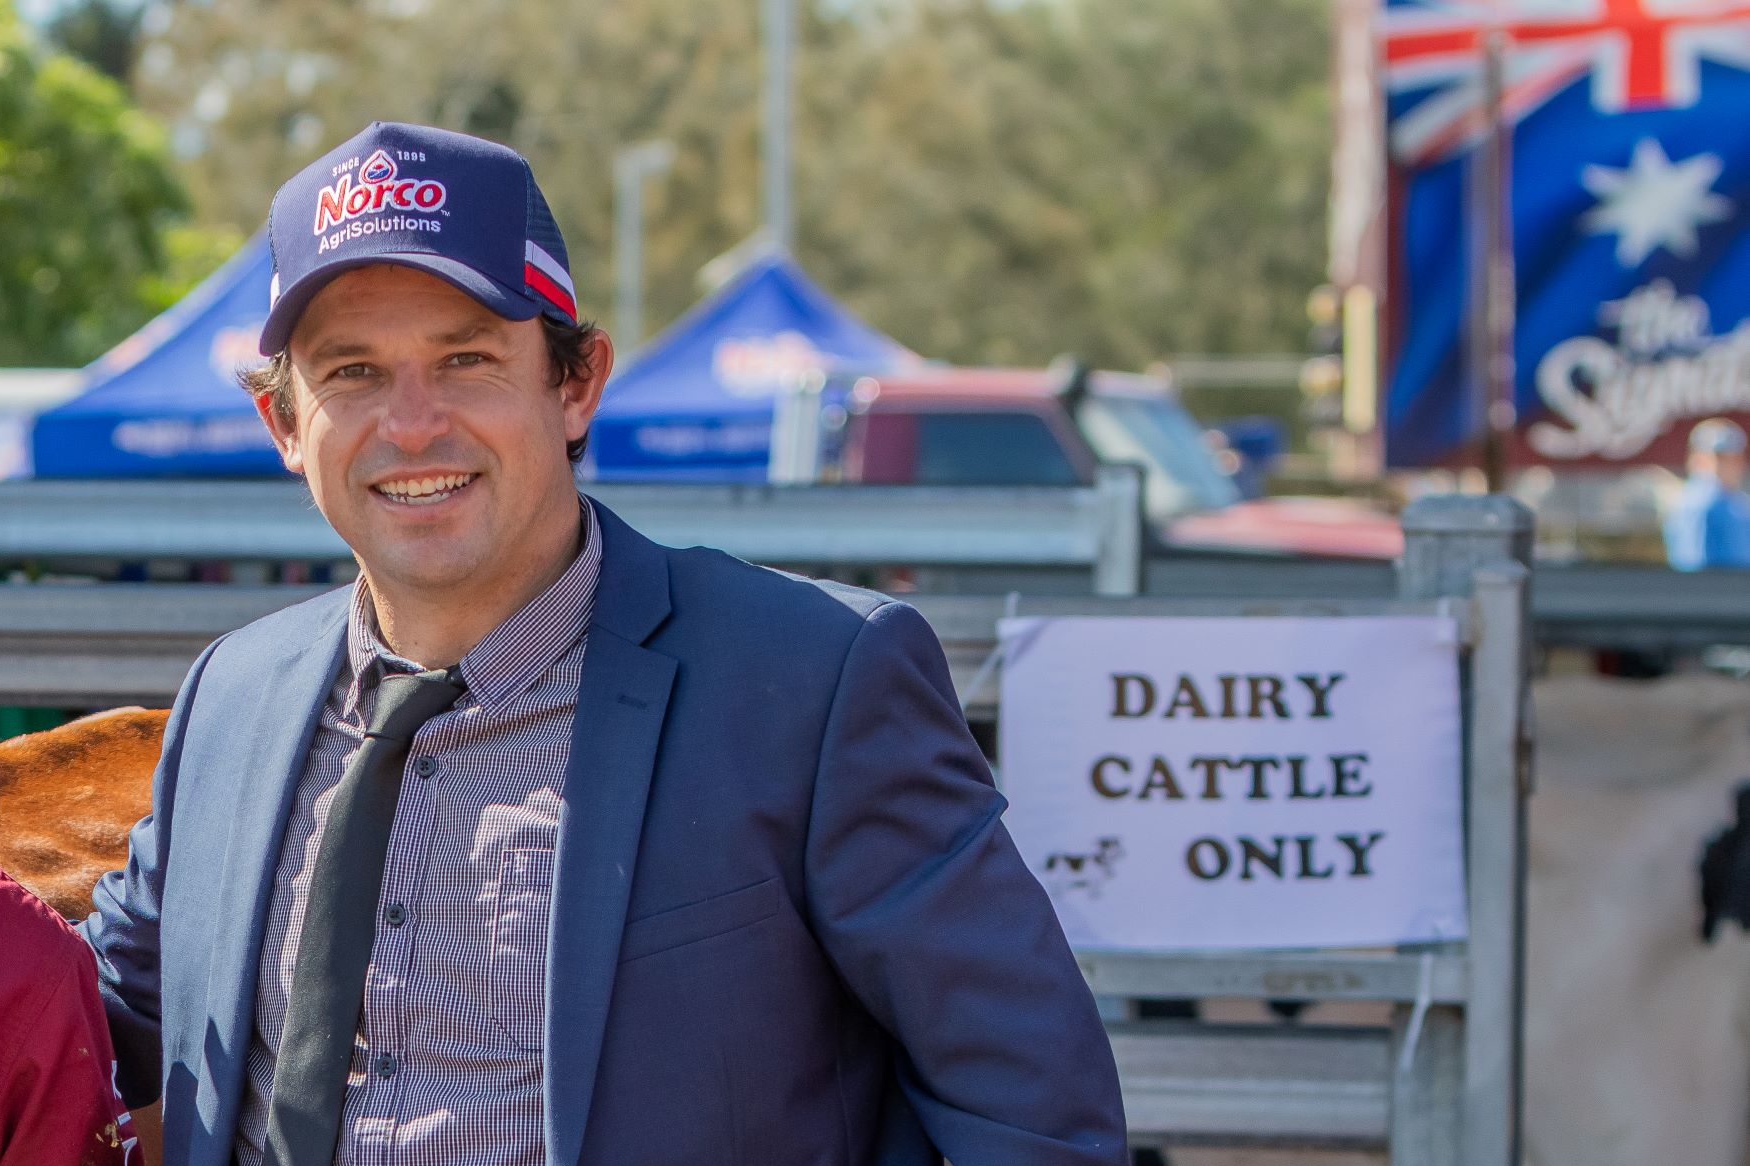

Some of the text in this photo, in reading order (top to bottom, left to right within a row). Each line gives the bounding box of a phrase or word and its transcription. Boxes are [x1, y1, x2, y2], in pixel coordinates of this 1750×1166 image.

[332, 150, 426, 177] SINCE 1895
[314, 173, 446, 236] Norco
[318, 215, 442, 254] AgriSolutions
[1110, 673, 1345, 719] DAIRY
[1090, 753, 1373, 800] CATTLE
[1185, 831, 1386, 880] ONLY
